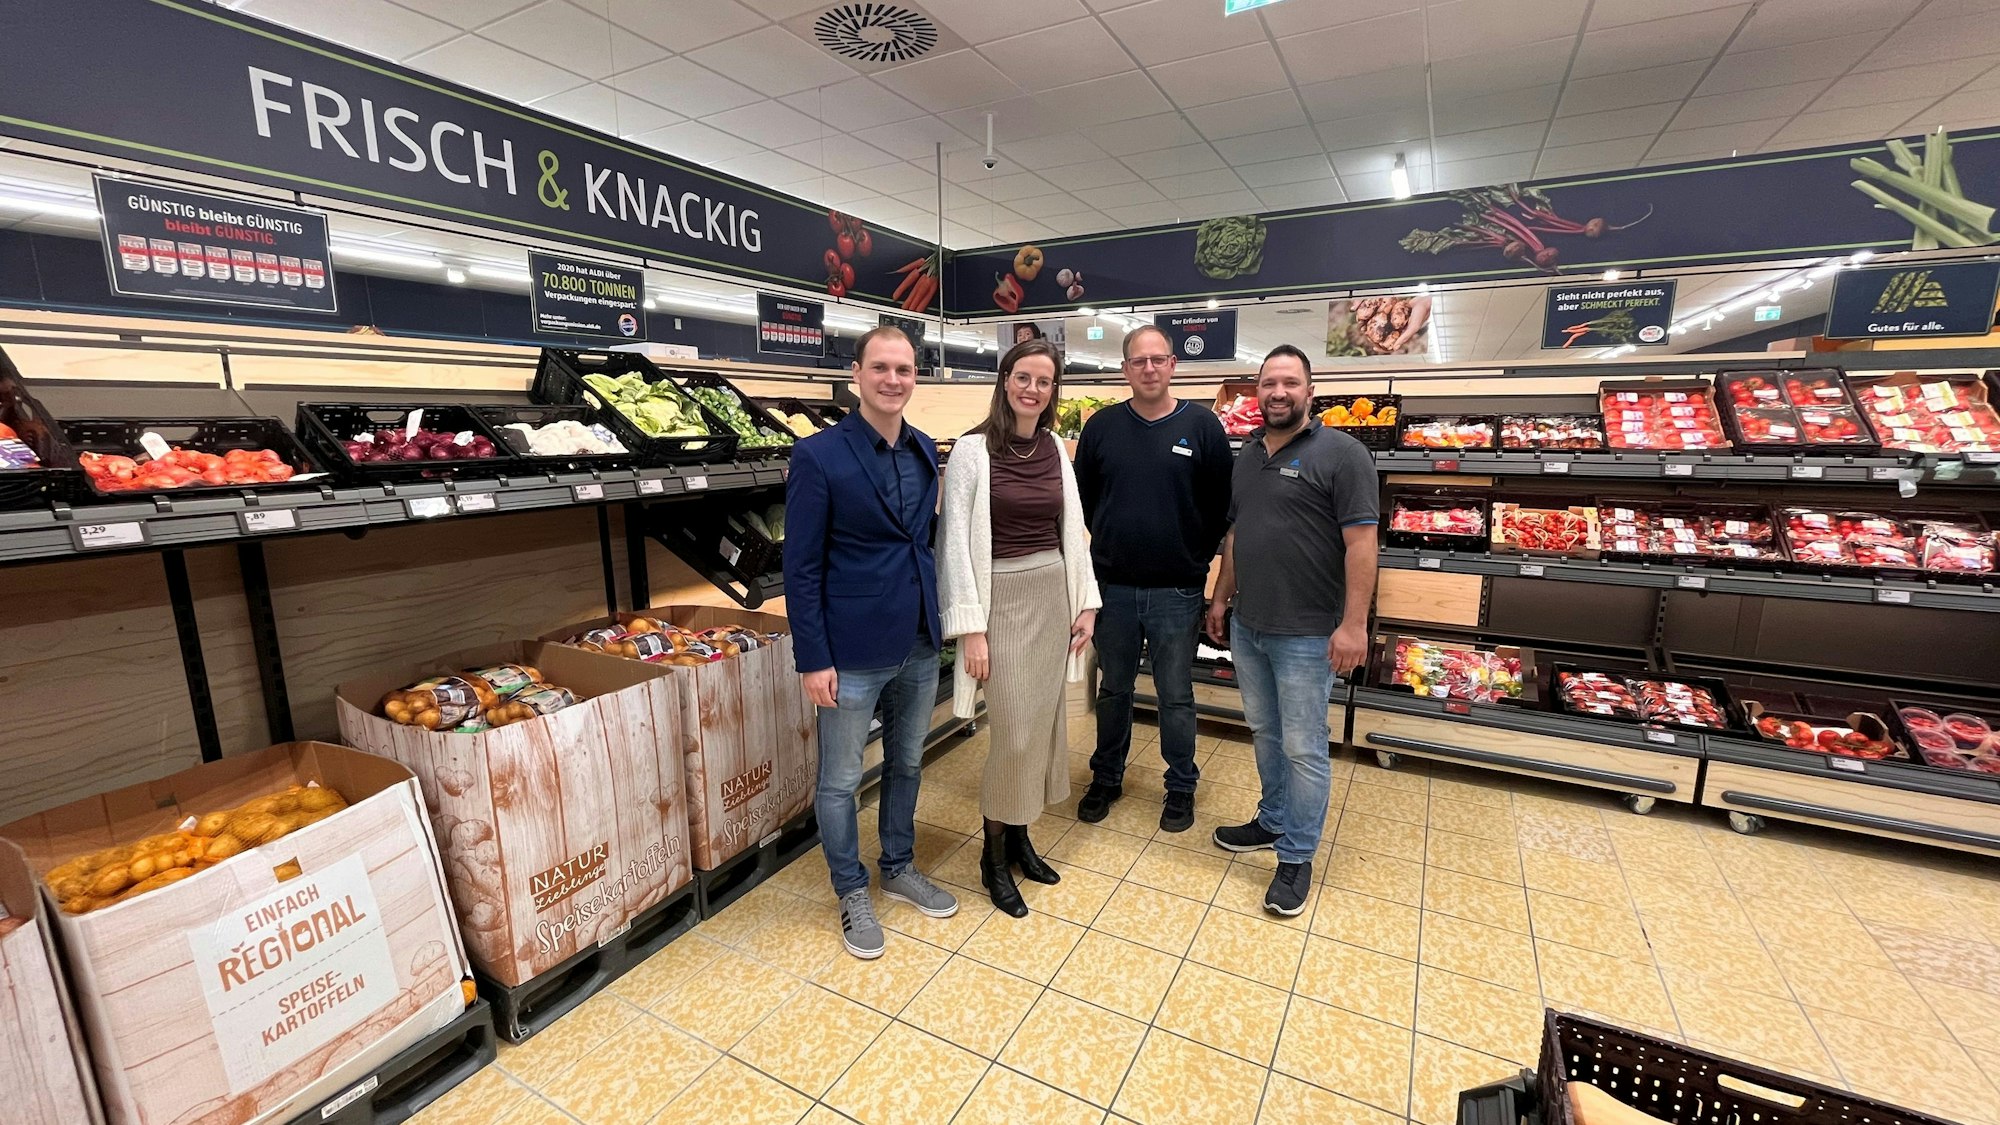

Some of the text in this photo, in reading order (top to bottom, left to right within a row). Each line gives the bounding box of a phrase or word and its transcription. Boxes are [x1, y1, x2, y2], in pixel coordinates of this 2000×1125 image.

[248, 66, 763, 254] FRISCH & KNACKIG
[127, 194, 303, 235] GÜNSTIG bleibt GÜNSTIG
[165, 218, 278, 245] bleibt GÜNSTIG.
[542, 272, 636, 300] 70.800 TONNEN
[557, 263, 621, 280] 2020 hat ALDI über
[544, 290, 597, 305] Verpackungen
[1556, 288, 1665, 302] Sieht nicht perfekt aus,
[1557, 297, 1661, 311] aber SCHMECKT PERFEKT.
[1183, 317, 1206, 325] Erfinder
[1867, 321, 1945, 333] Gutes für alle.
[80, 526, 106, 537] 3,29
[246, 512, 266, 521] -,89
[722, 761, 771, 797] NATUR
[724, 777, 770, 811] Lieblinge
[723, 760, 816, 846] Speisekartoffeln
[532, 844, 607, 893] NATUR
[535, 834, 681, 955] Speisekartoffeln
[536, 862, 606, 911] Lieblinge
[244, 883, 321, 933] EINFACH
[217, 895, 367, 992] REGIONAL
[261, 973, 366, 1047] KARTOFFELN
[278, 970, 342, 1015] SPEISE-
